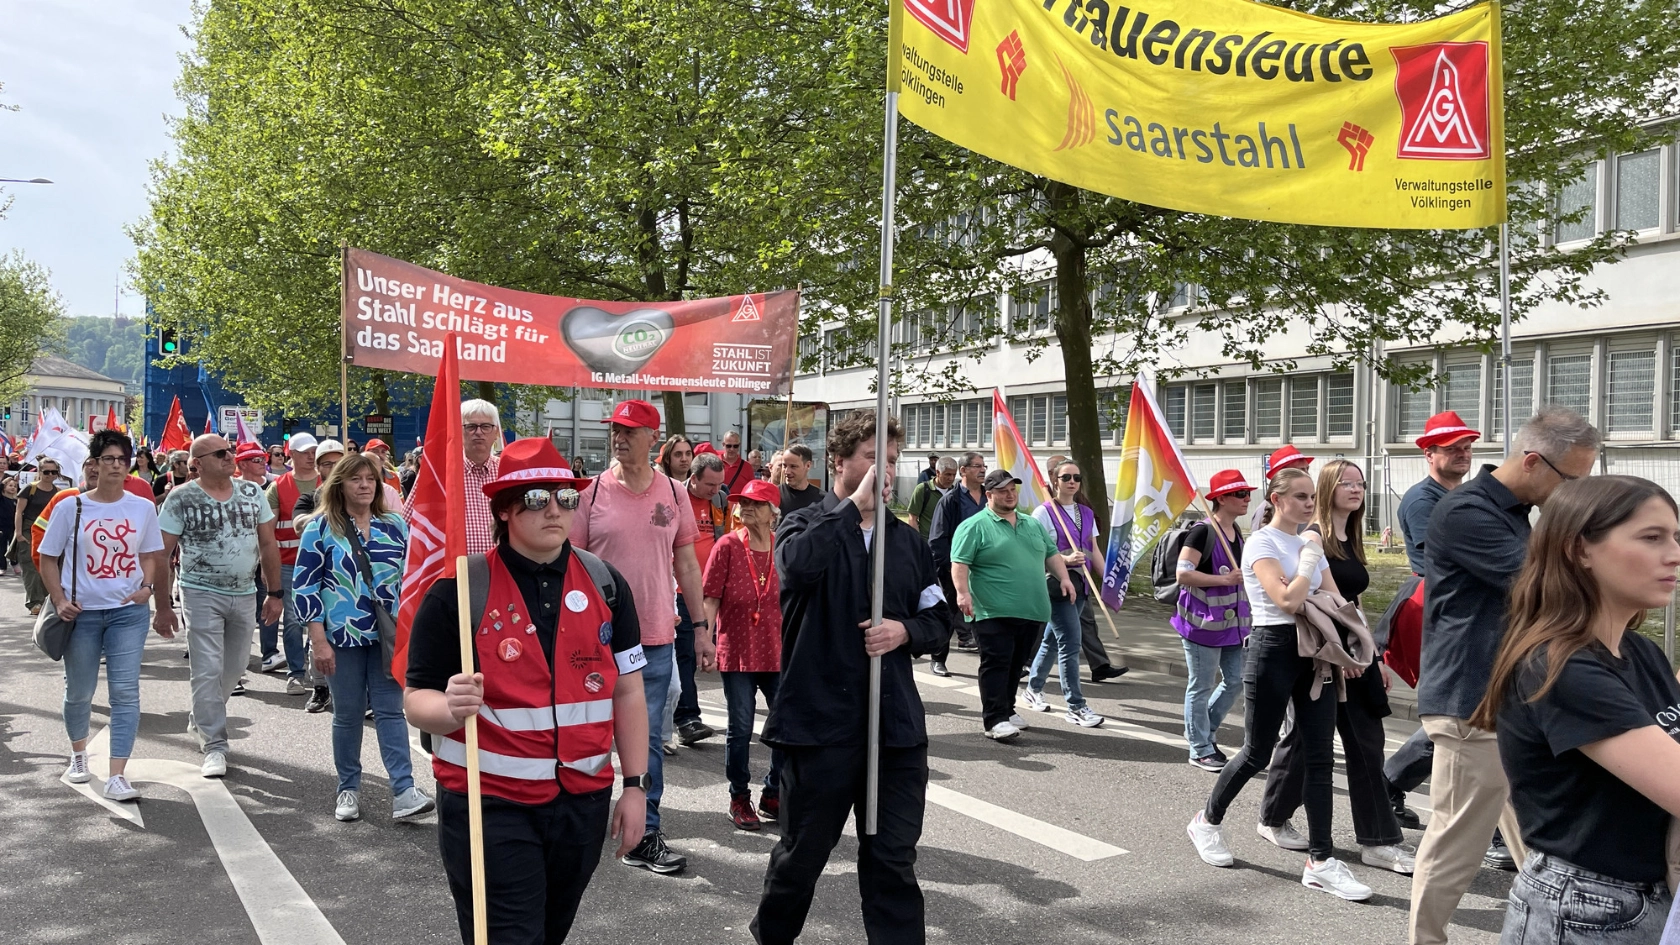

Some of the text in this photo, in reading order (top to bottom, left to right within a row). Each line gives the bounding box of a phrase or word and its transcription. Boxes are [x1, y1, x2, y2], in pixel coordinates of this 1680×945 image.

[1104, 107, 1306, 169] saarstahl
[1395, 178, 1493, 194] Verwaltungstelle
[1410, 196, 1471, 211] Völklingen
[357, 267, 534, 323] Unser Herz aus
[357, 296, 549, 344] Stahl schlägt für
[356, 326, 506, 363] das Saaland
[713, 347, 772, 360] STAHL IST
[712, 359, 771, 372] ZUKUNFT
[591, 371, 771, 391] IG Metall-Vertrauensleute Dillinger
